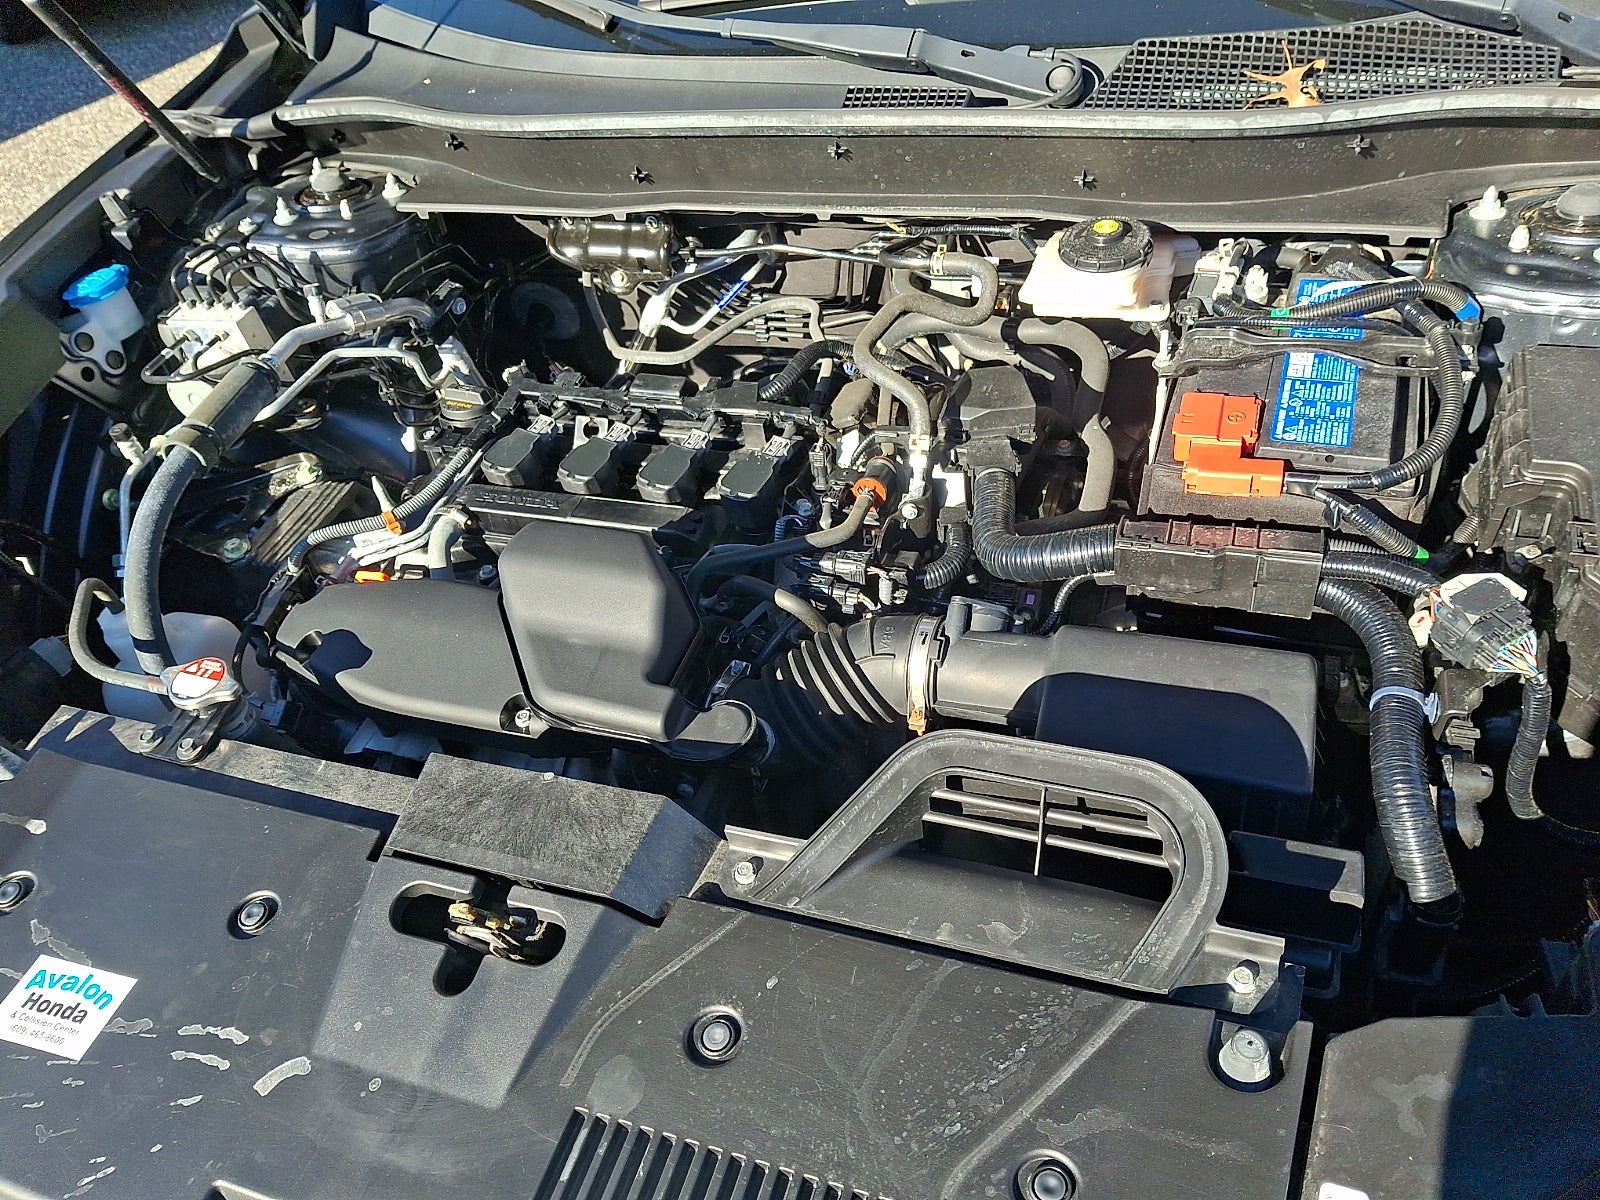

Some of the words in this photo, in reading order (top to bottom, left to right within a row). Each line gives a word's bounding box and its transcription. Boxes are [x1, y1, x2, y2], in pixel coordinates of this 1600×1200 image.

[24, 969, 114, 1011] Avalon
[10, 1010, 18, 1019] &
[18, 1012, 53, 1028] Collision
[53, 1022, 81, 1036] Center
[20, 991, 88, 1025] Honda
